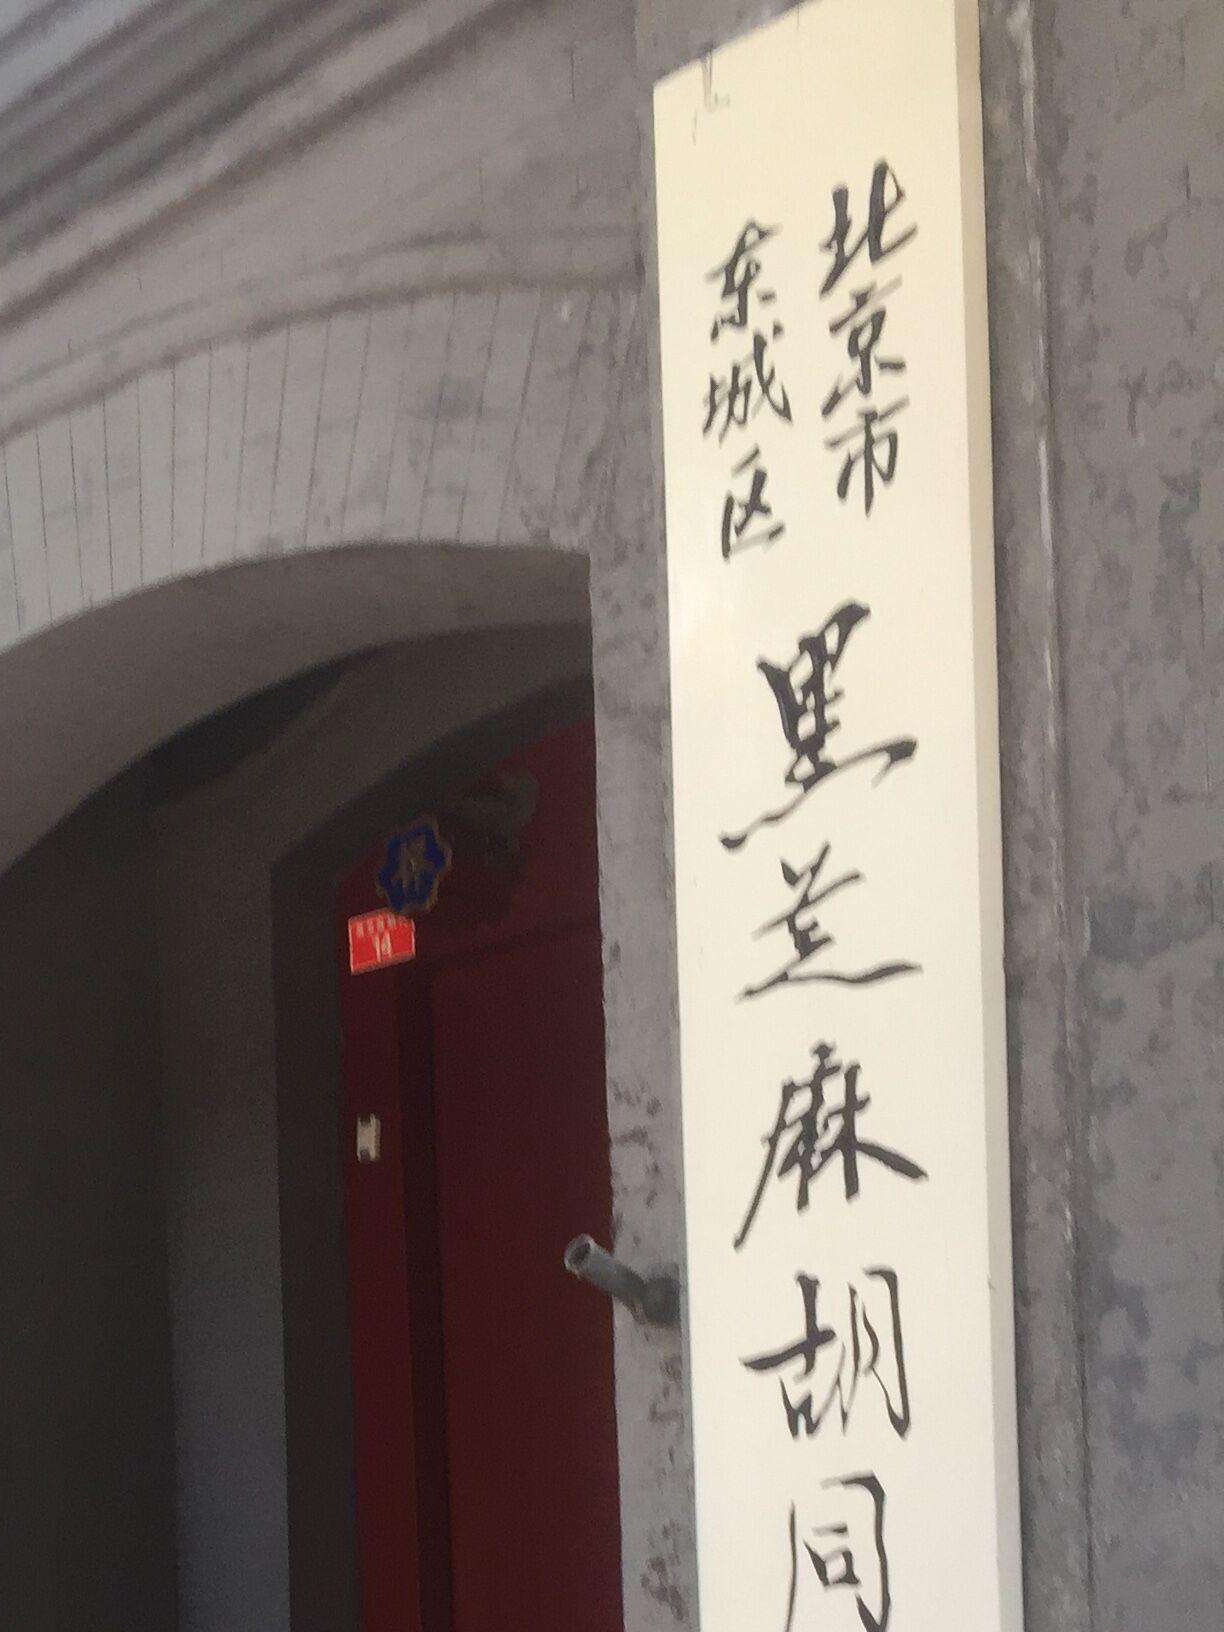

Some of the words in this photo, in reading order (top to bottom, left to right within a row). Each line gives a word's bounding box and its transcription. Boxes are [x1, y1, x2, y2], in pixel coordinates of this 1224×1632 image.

[702, 218, 793, 560] 东城区
[817, 157, 918, 518] 北京市
